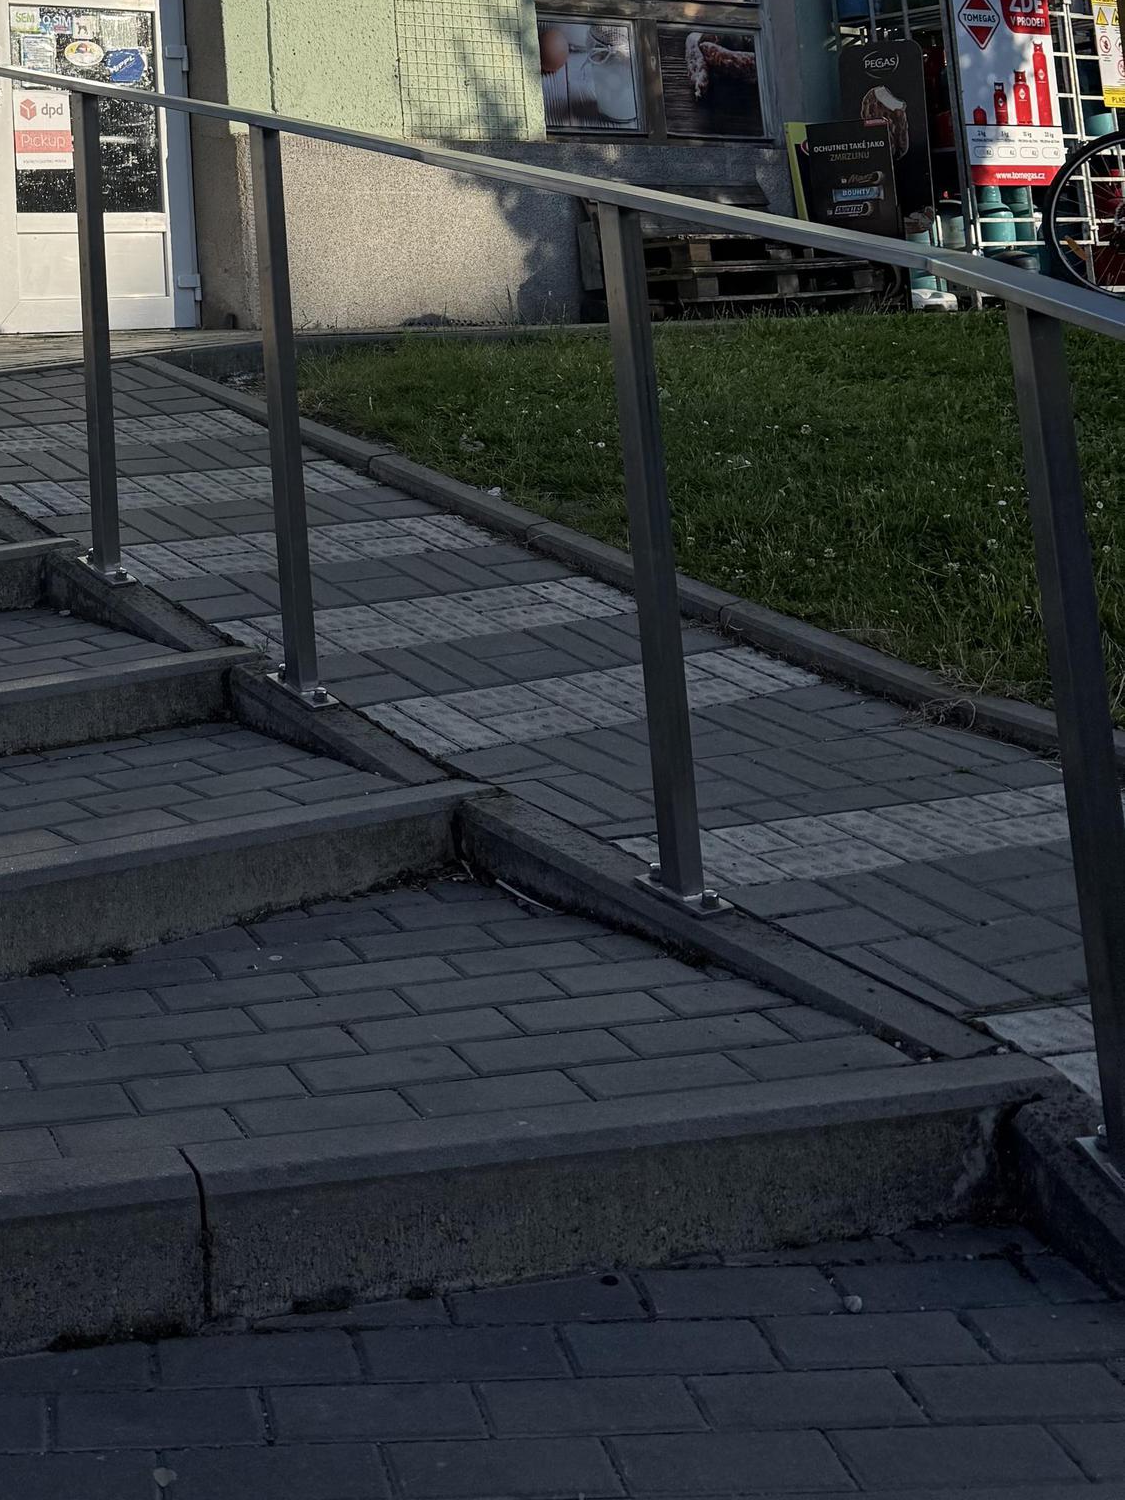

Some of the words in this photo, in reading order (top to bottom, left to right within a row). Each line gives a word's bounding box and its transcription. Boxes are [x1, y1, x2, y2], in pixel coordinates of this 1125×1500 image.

[15, 11, 35, 24] SEM
[53, 14, 72, 27] SIM
[963, 13, 996, 23] TOMEGAS
[864, 57, 896, 69] PEGAS
[41, 102, 64, 119] dpd
[21, 133, 66, 149] Pickup
[813, 143, 848, 153] OCHUTNEJ
[849, 140, 866, 150] TAKÉ
[866, 140, 885, 149] JAKO
[842, 187, 871, 197] BOUNTY
